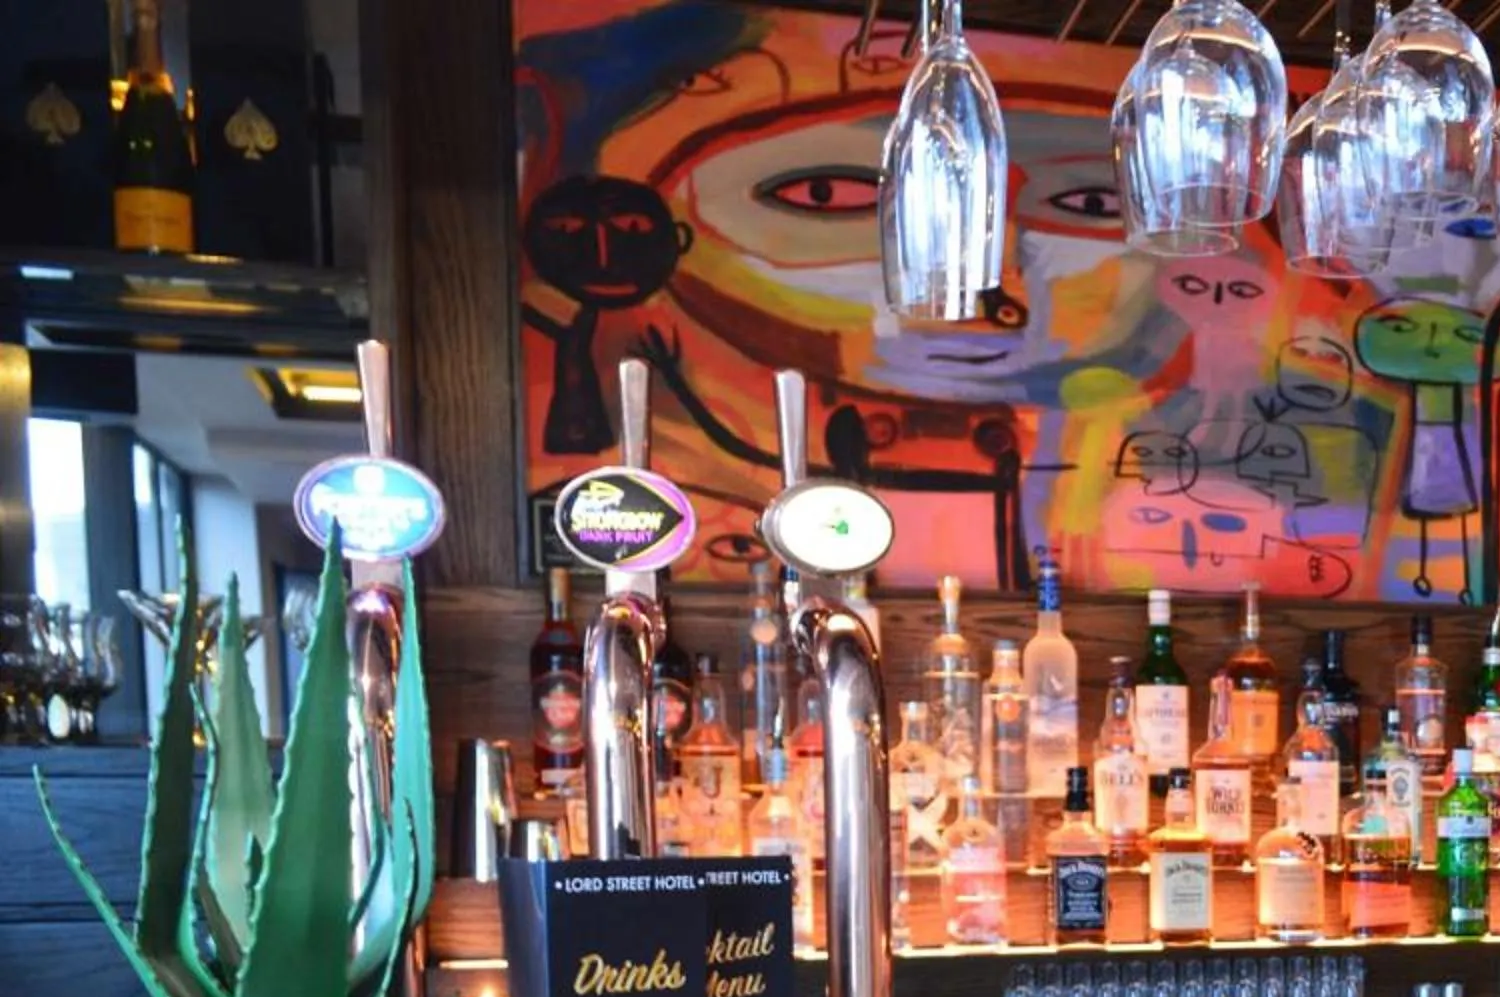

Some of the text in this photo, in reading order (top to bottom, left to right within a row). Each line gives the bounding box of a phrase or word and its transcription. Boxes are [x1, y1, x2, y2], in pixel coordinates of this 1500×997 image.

[615, 529, 653, 543] FRUIT
[564, 874, 696, 893] LORD STREET HOTEL
[706, 869, 781, 886] TREET HOTEL
[706, 921, 775, 964] ktail
[573, 949, 686, 996] Drinks
